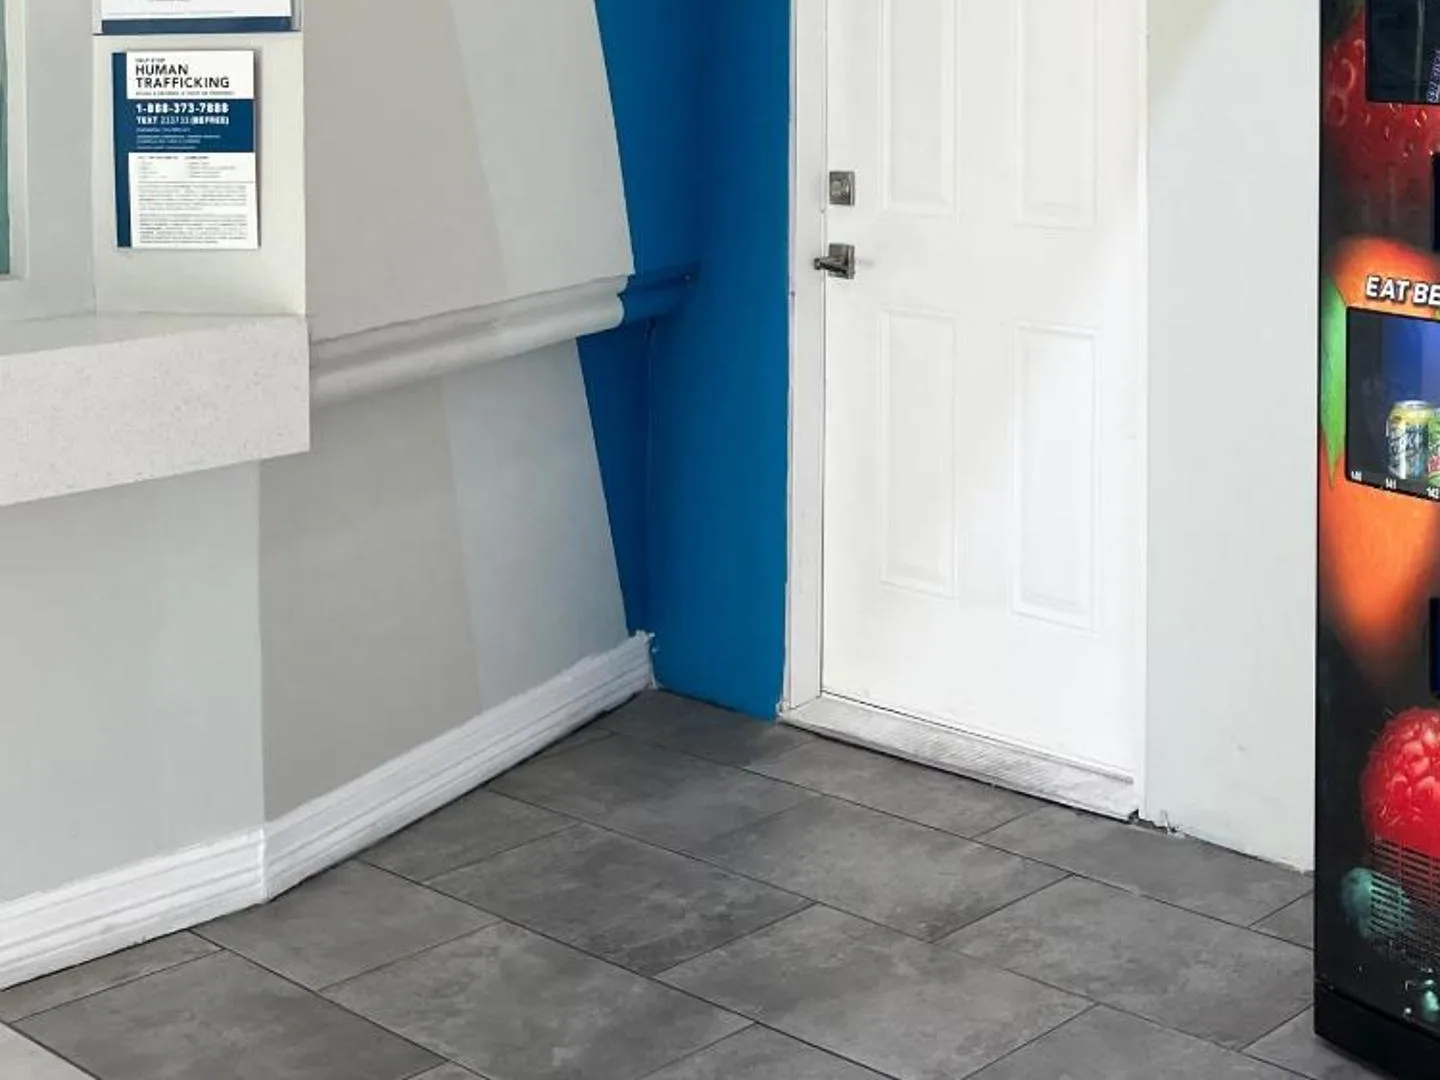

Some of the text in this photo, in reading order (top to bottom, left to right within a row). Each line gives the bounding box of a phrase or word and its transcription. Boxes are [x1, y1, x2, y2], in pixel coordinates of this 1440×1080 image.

[135, 64, 188, 75] HUMAN
[136, 77, 230, 88] TRAFFICKING
[136, 102, 229, 113] 1-888-373-7888
[136, 116, 157, 125] TEXT
[1365, 276, 1408, 302] EAT
